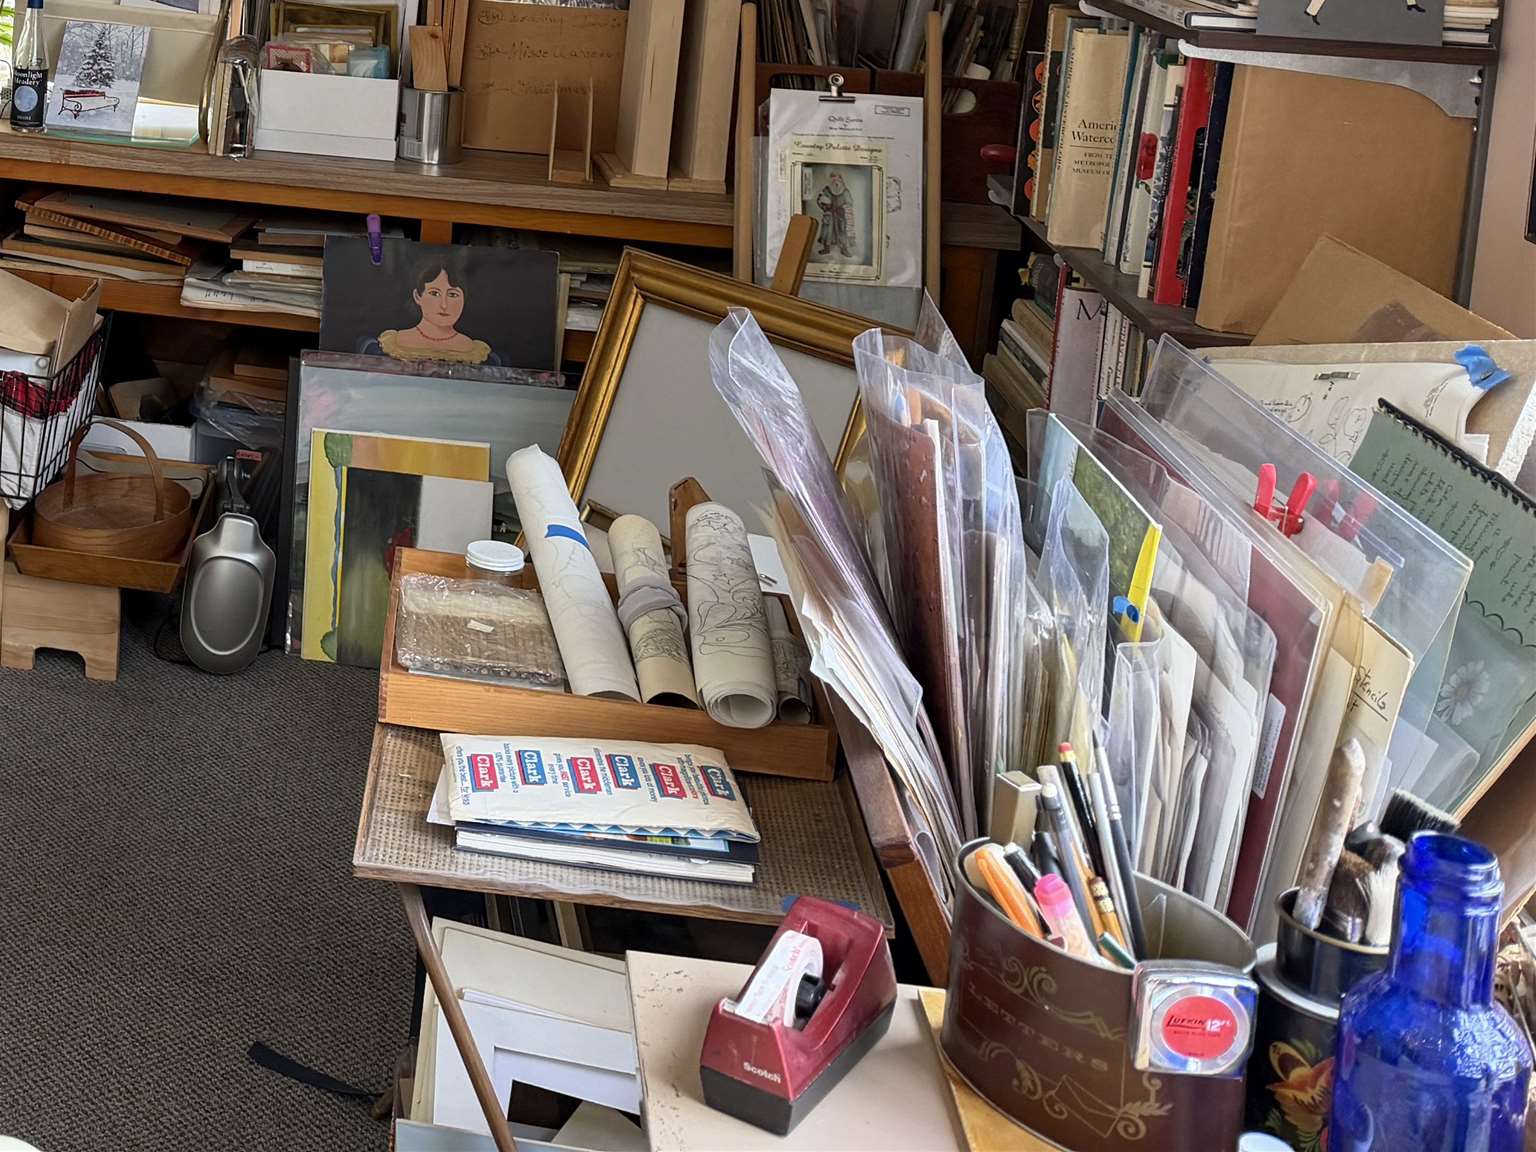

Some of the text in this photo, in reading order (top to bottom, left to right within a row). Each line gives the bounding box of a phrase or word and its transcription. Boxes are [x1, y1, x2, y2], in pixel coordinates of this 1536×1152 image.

[477, 755, 494, 787] Clark
[524, 752, 541, 783] Clark
[577, 758, 596, 789] Clark
[615, 756, 635, 786] Clark
[659, 766, 680, 794] Clark
[708, 768, 729, 796] Clark
[743, 1061, 782, 1084] Scotch
